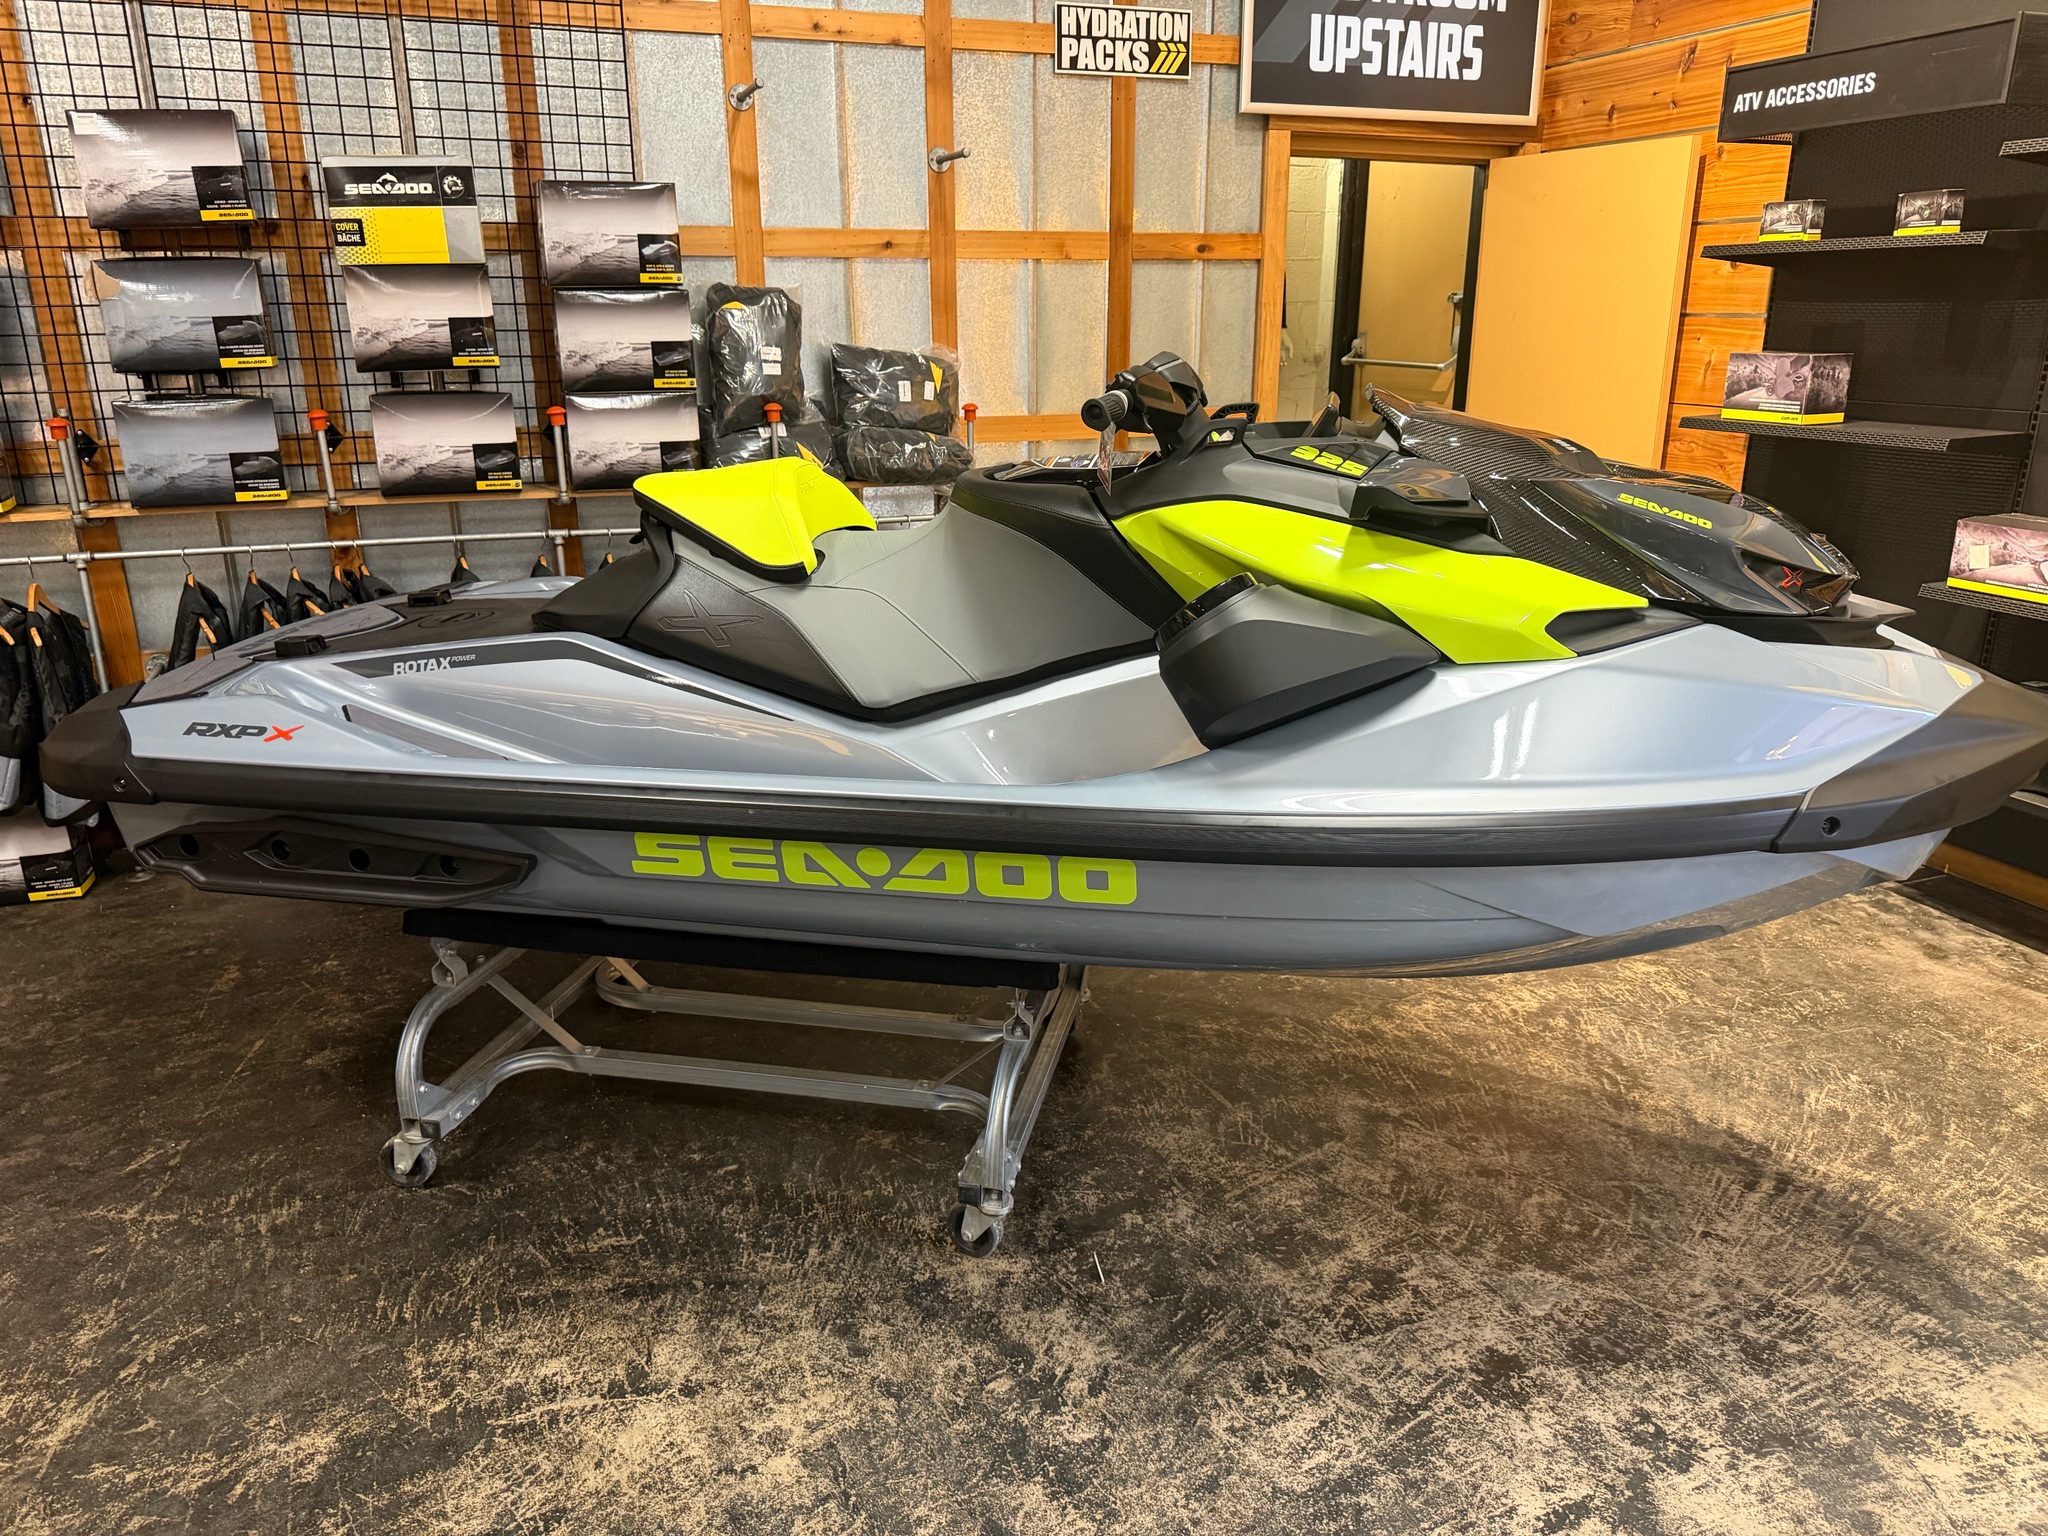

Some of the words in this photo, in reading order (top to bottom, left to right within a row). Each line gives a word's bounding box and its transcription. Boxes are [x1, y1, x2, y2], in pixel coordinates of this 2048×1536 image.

[1061, 6, 1189, 42] HYDRATION
[1061, 37, 1150, 73] PACKS
[1309, 13, 1484, 81] UPSTAIRS
[1733, 91, 1763, 113] ATV
[1764, 72, 1877, 109] ACCESSORIES
[335, 222, 359, 231] COVER
[337, 233, 362, 243] BÂCHE
[1290, 445, 1369, 476] 325
[393, 656, 452, 676] ROTAX
[451, 654, 476, 662] POWER
